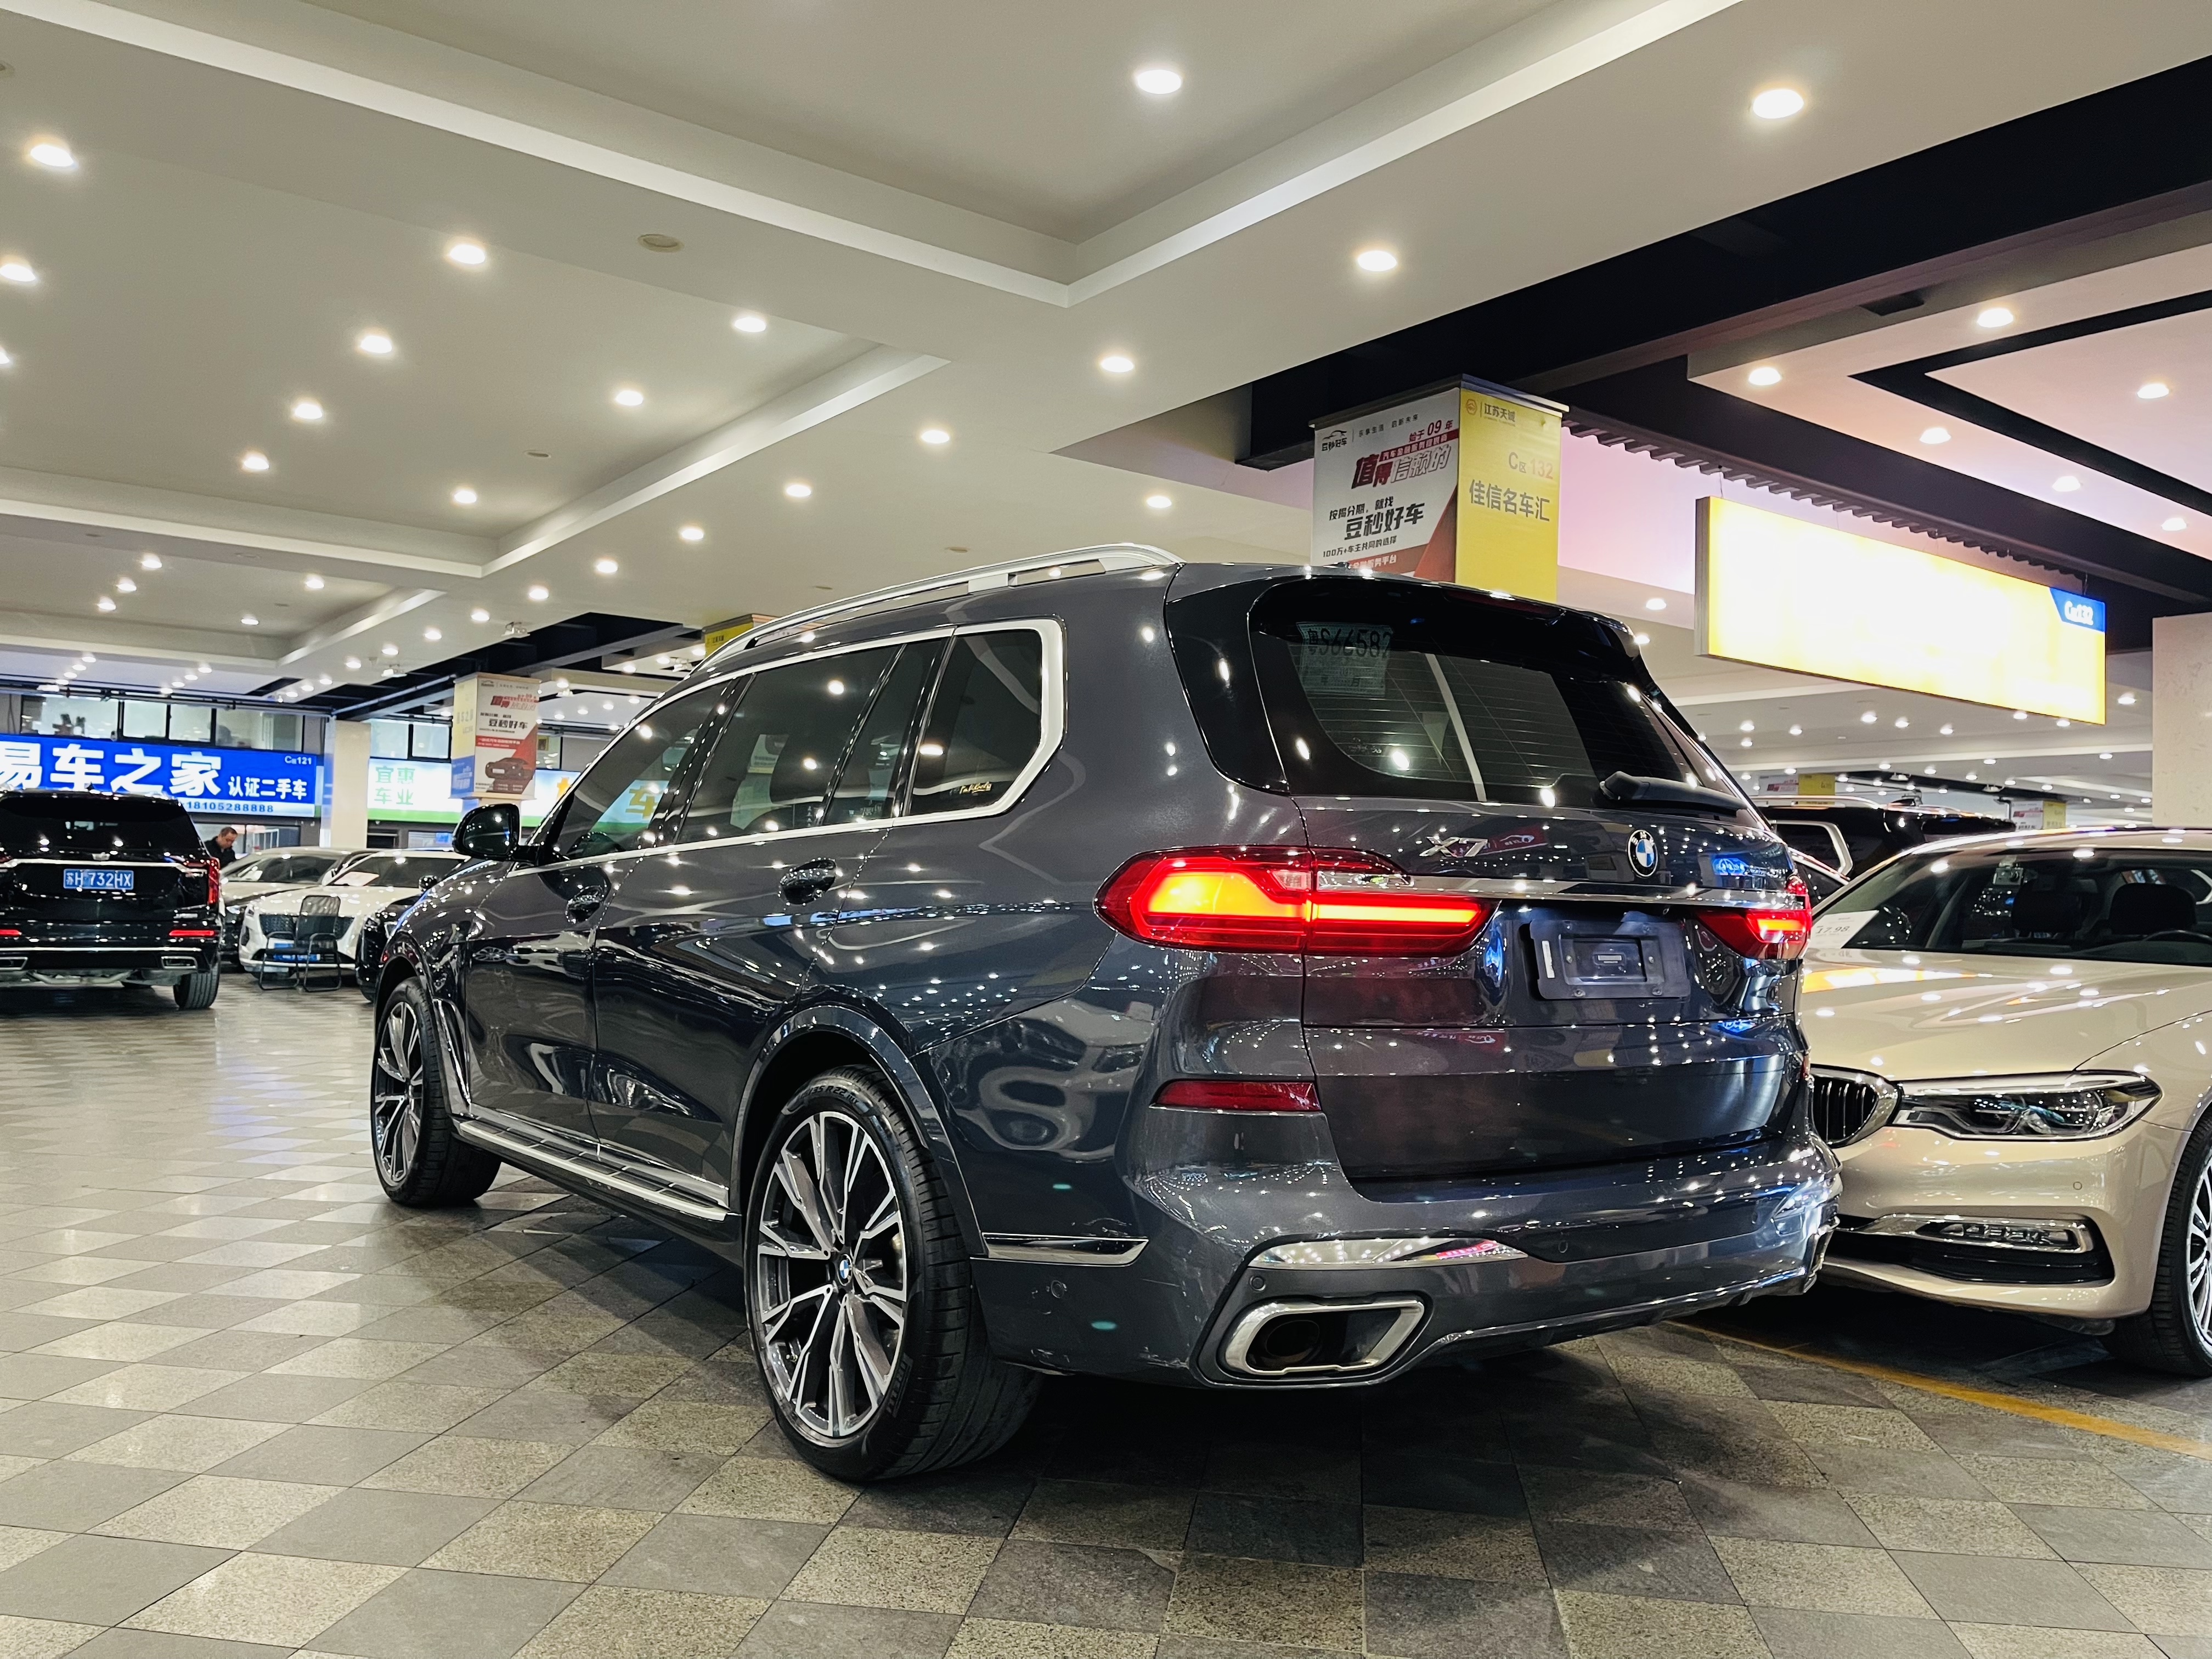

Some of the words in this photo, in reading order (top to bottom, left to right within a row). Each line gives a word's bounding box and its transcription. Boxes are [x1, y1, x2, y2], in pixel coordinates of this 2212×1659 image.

[1351, 443, 1452, 489] 值得信赖的
[1509, 452, 1527, 473] C区
[1530, 458, 1554, 480] 132
[1469, 479, 1550, 522] 佳信名车汇
[1344, 503, 1425, 540] 豆秒好车
[2064, 601, 2094, 626] C132
[0, 741, 221, 797] 易车之家
[284, 755, 312, 765] C121
[228, 775, 307, 800] 认证二手车
[374, 787, 414, 805] 车业
[188, 801, 273, 812] 18105288888
[1419, 836, 1488, 857] X7
[88, 872, 131, 887] 732HX
